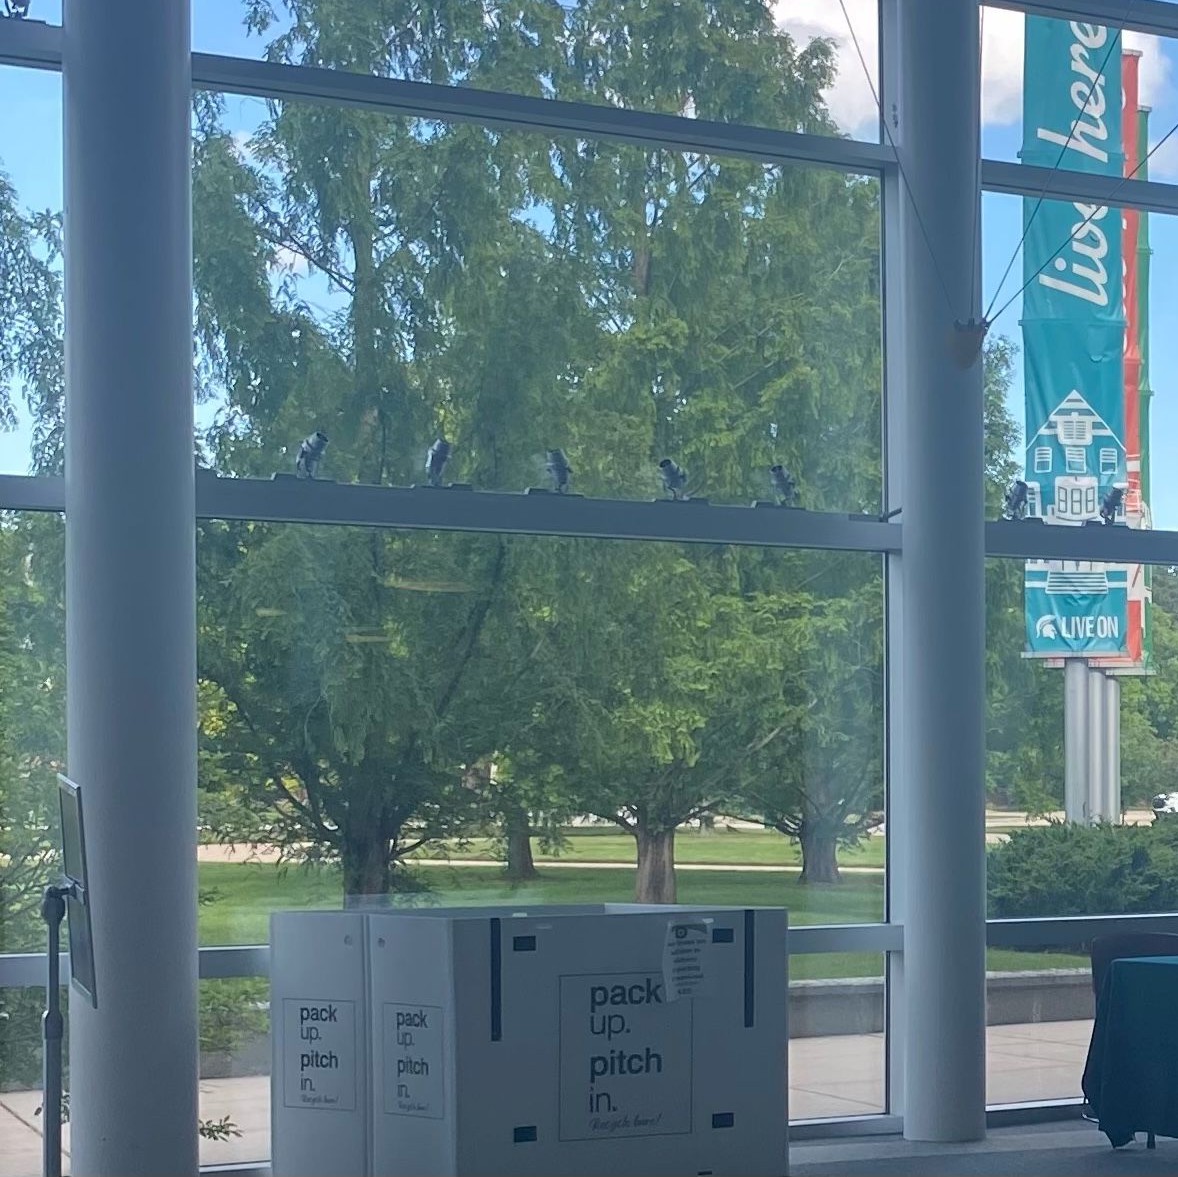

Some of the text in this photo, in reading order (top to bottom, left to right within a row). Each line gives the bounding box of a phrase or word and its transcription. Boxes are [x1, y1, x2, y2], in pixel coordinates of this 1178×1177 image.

[1036, 20, 1109, 163] here
[1061, 615, 1119, 639] LIVE ON
[590, 977, 663, 1013] pack
[300, 1003, 338, 1025] pack
[396, 1009, 429, 1031] pack
[300, 1026, 322, 1045] up.
[590, 1014, 631, 1041] up.
[396, 1031, 416, 1051] up.
[300, 1049, 339, 1072] pitch
[397, 1055, 429, 1078] pitch
[589, 1047, 663, 1083] pitch
[300, 1073, 316, 1092] in.
[589, 1086, 618, 1113] in.
